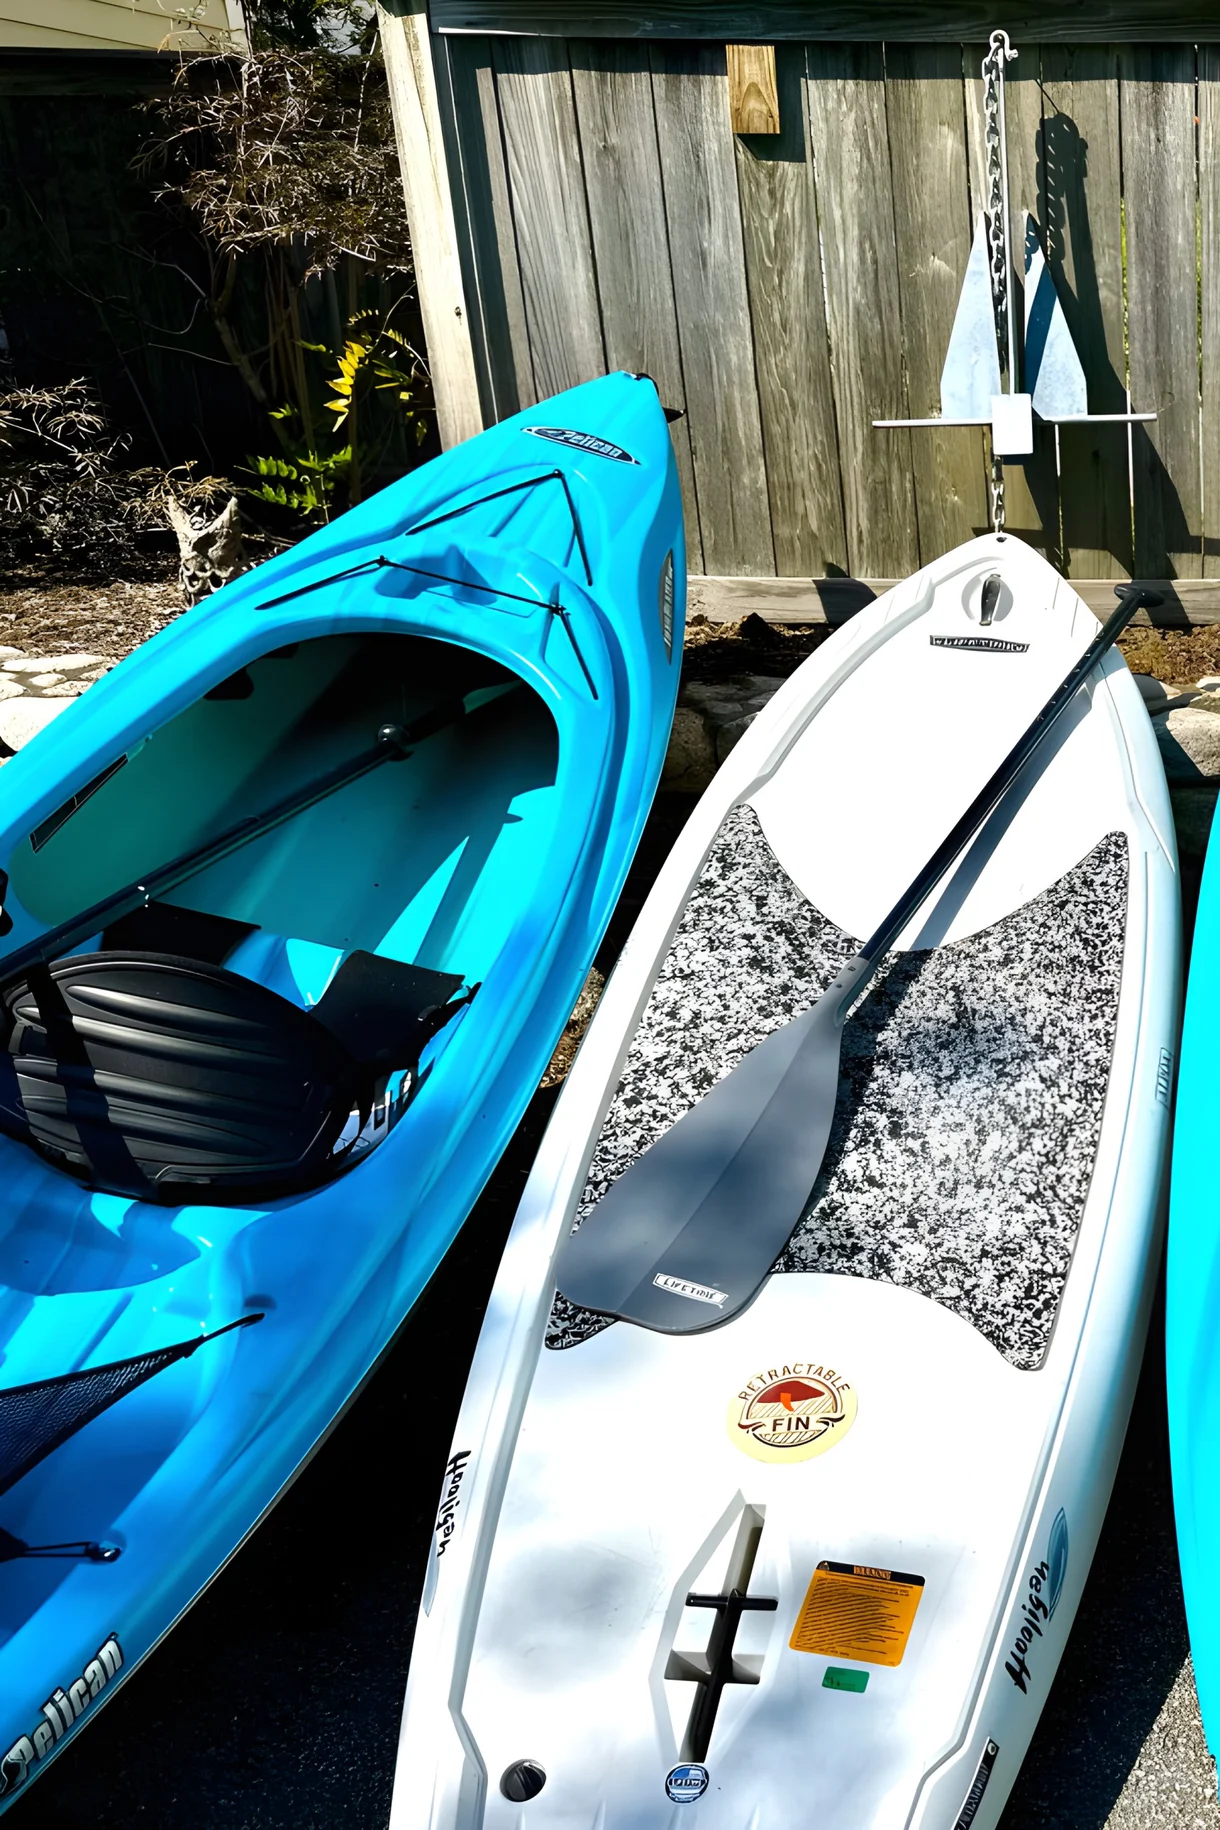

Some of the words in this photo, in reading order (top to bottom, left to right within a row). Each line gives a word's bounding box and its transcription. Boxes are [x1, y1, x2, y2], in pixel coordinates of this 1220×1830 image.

[738, 1363, 851, 1402] RETRACTABLE
[772, 1416, 810, 1432] FIN
[1, 1638, 125, 1797] Pelican
